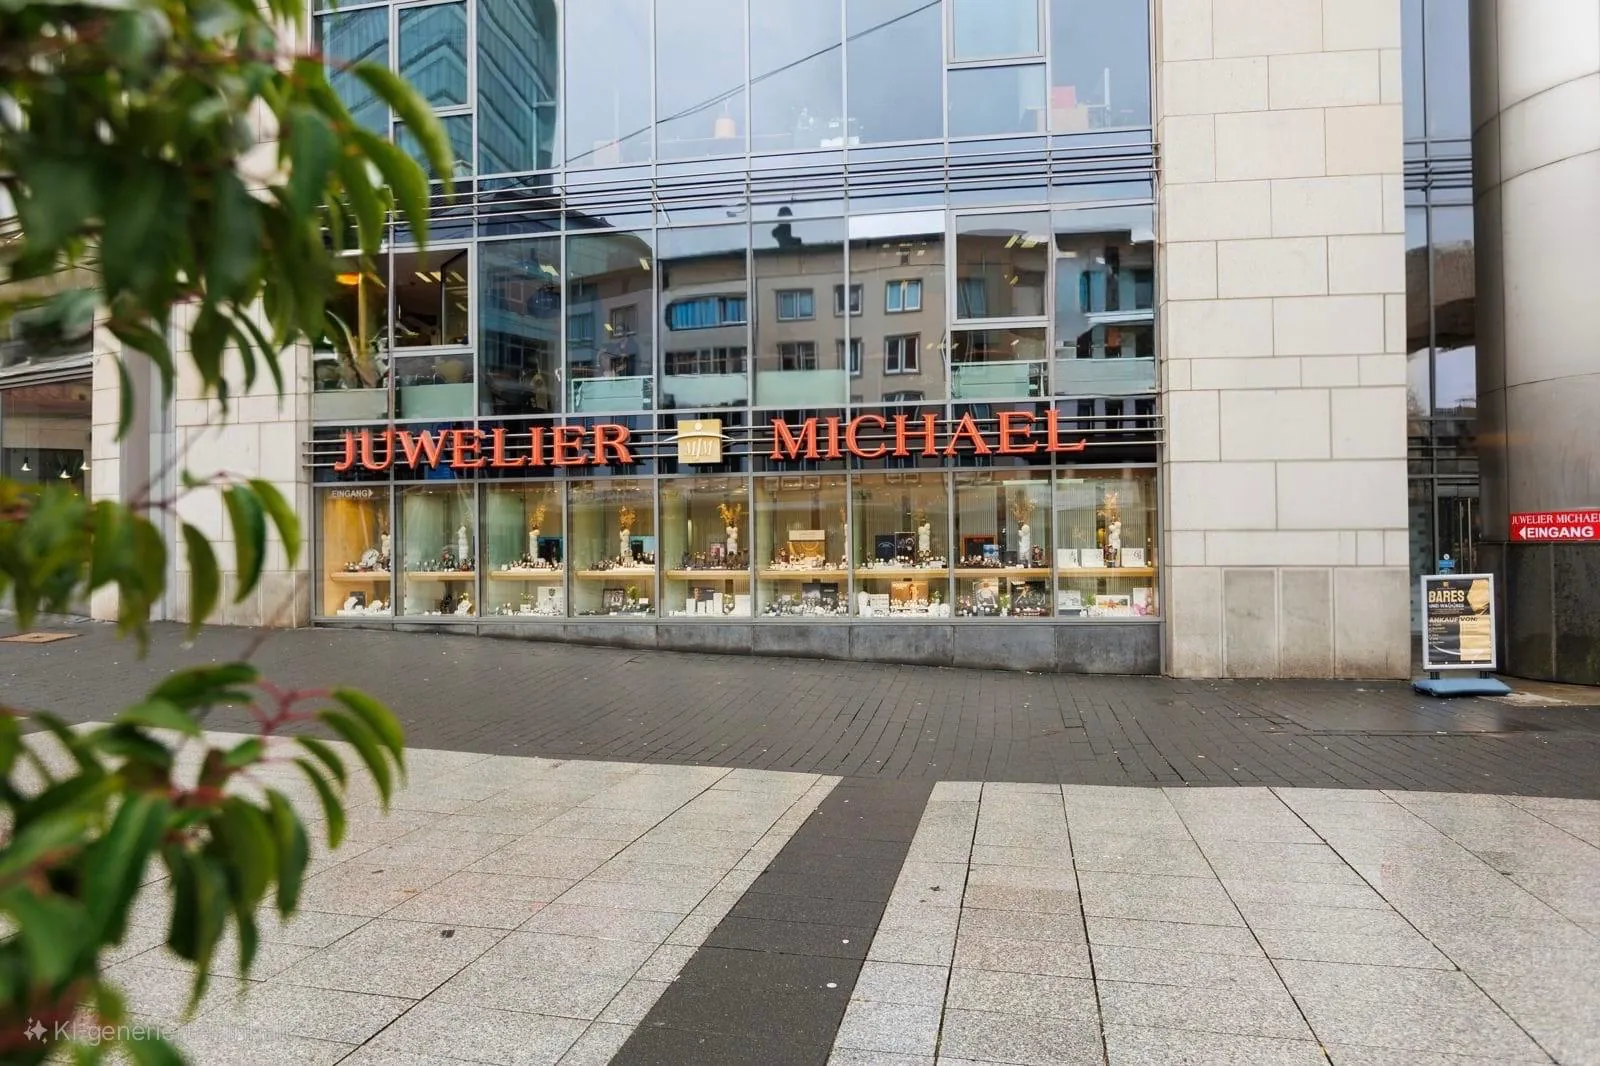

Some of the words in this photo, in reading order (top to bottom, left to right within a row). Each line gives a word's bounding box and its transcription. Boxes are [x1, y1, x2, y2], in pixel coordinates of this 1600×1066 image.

[334, 424, 633, 471] JUWELIER
[770, 409, 1086, 460] MICHAEL
[331, 488, 368, 498] EINGANG
[1511, 514, 1553, 525] JUWELIER
[1556, 513, 1600, 524] MICHAE
[1527, 526, 1594, 538] EINGANG
[1428, 590, 1465, 603] BARES
